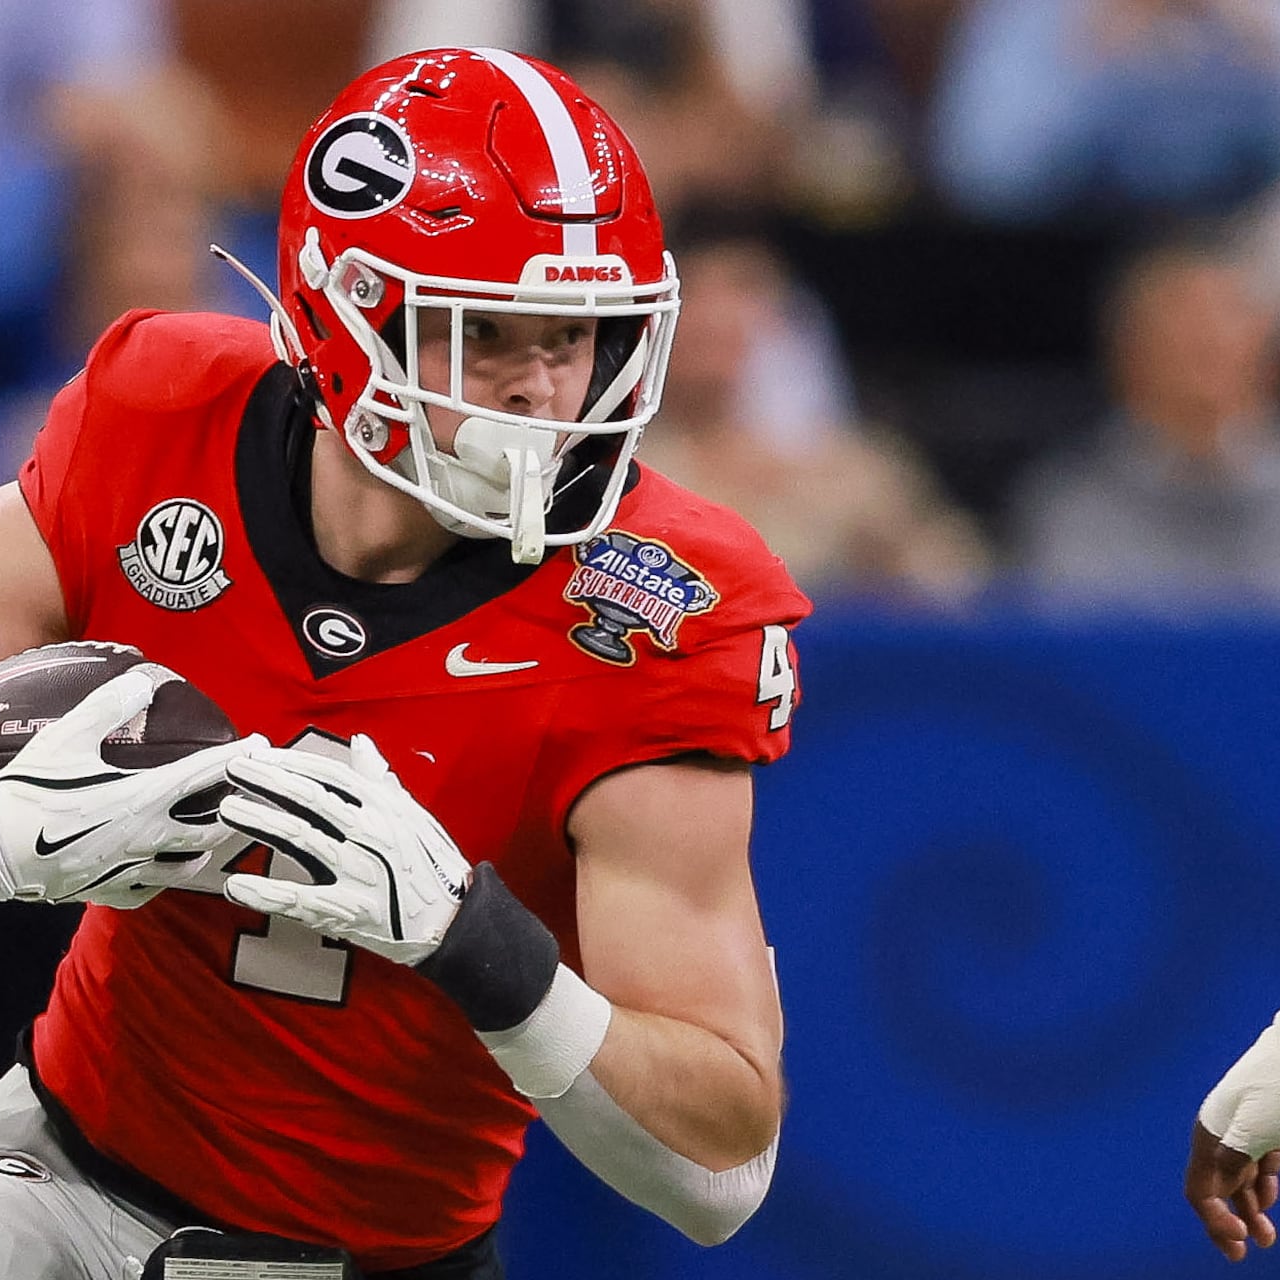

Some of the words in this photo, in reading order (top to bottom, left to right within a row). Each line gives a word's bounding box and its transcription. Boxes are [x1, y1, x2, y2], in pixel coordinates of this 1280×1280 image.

[307, 115, 414, 215] G
[544, 266, 622, 282] DAWGS
[144, 505, 217, 583] SEC
[127, 563, 211, 609] GRADUATE
[312, 614, 365, 652] G
[757, 624, 795, 732] 4
[1, 717, 61, 735] ELIT
